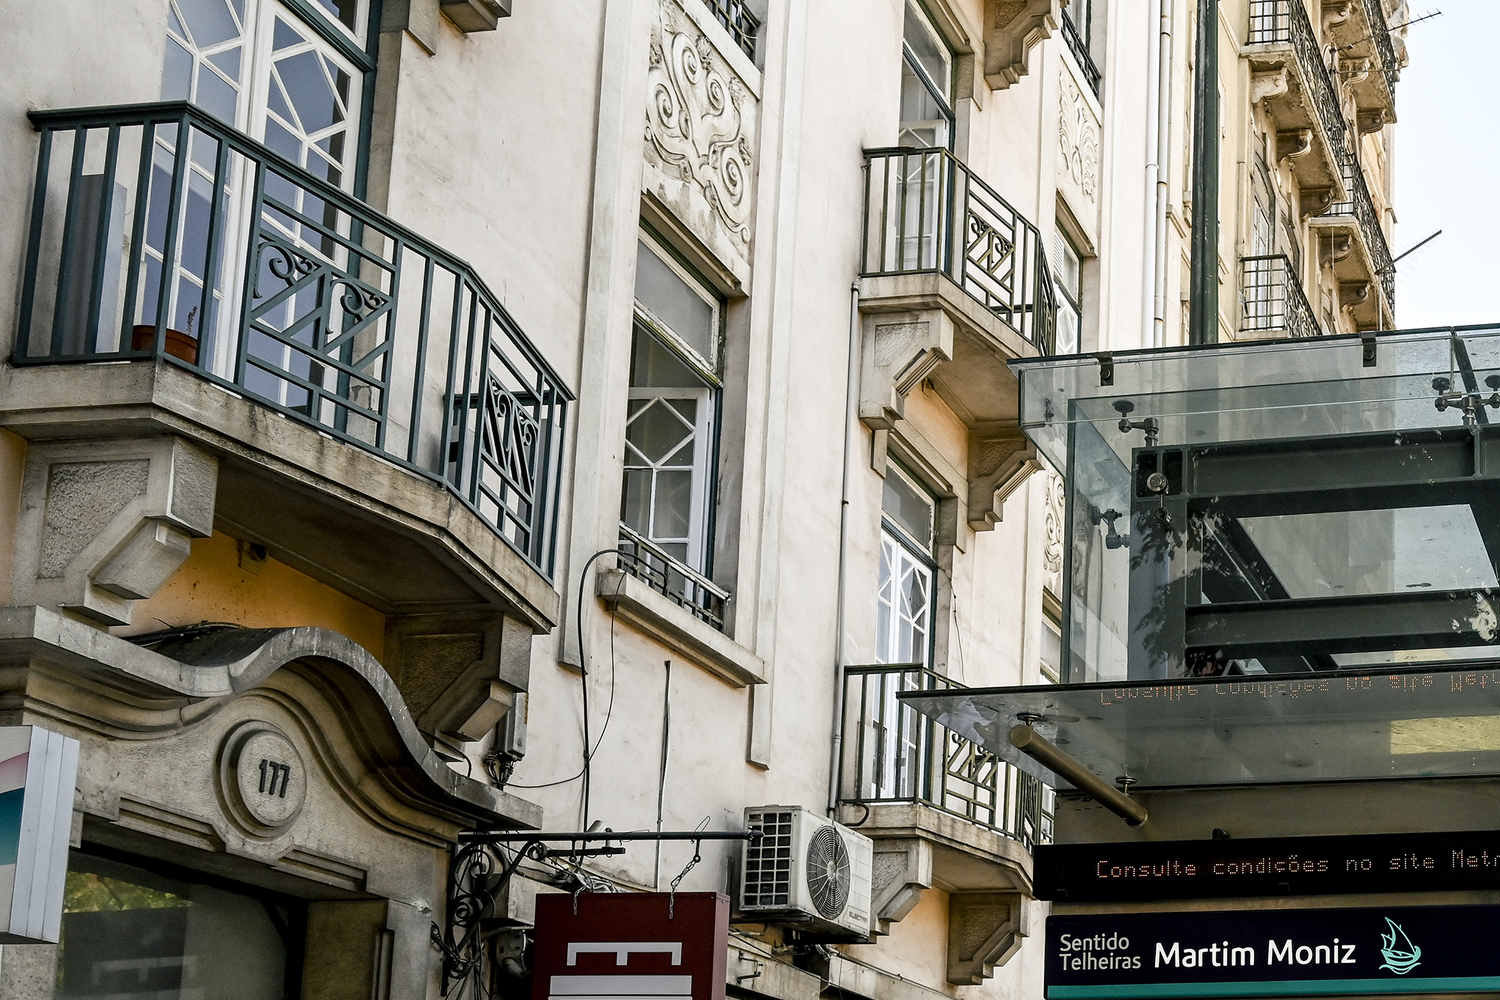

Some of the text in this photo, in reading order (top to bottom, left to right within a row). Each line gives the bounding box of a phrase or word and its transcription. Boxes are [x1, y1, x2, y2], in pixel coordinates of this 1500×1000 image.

[258, 759, 290, 798] 177
[1096, 860, 1197, 878] Consulte
[1213, 854, 1329, 875] condições
[1346, 858, 1372, 871] no
[1389, 853, 1434, 870] site
[1059, 932, 1130, 952] Sentido
[1154, 937, 1356, 968] Martim Moniz
[1059, 952, 1142, 971] Telheiras
